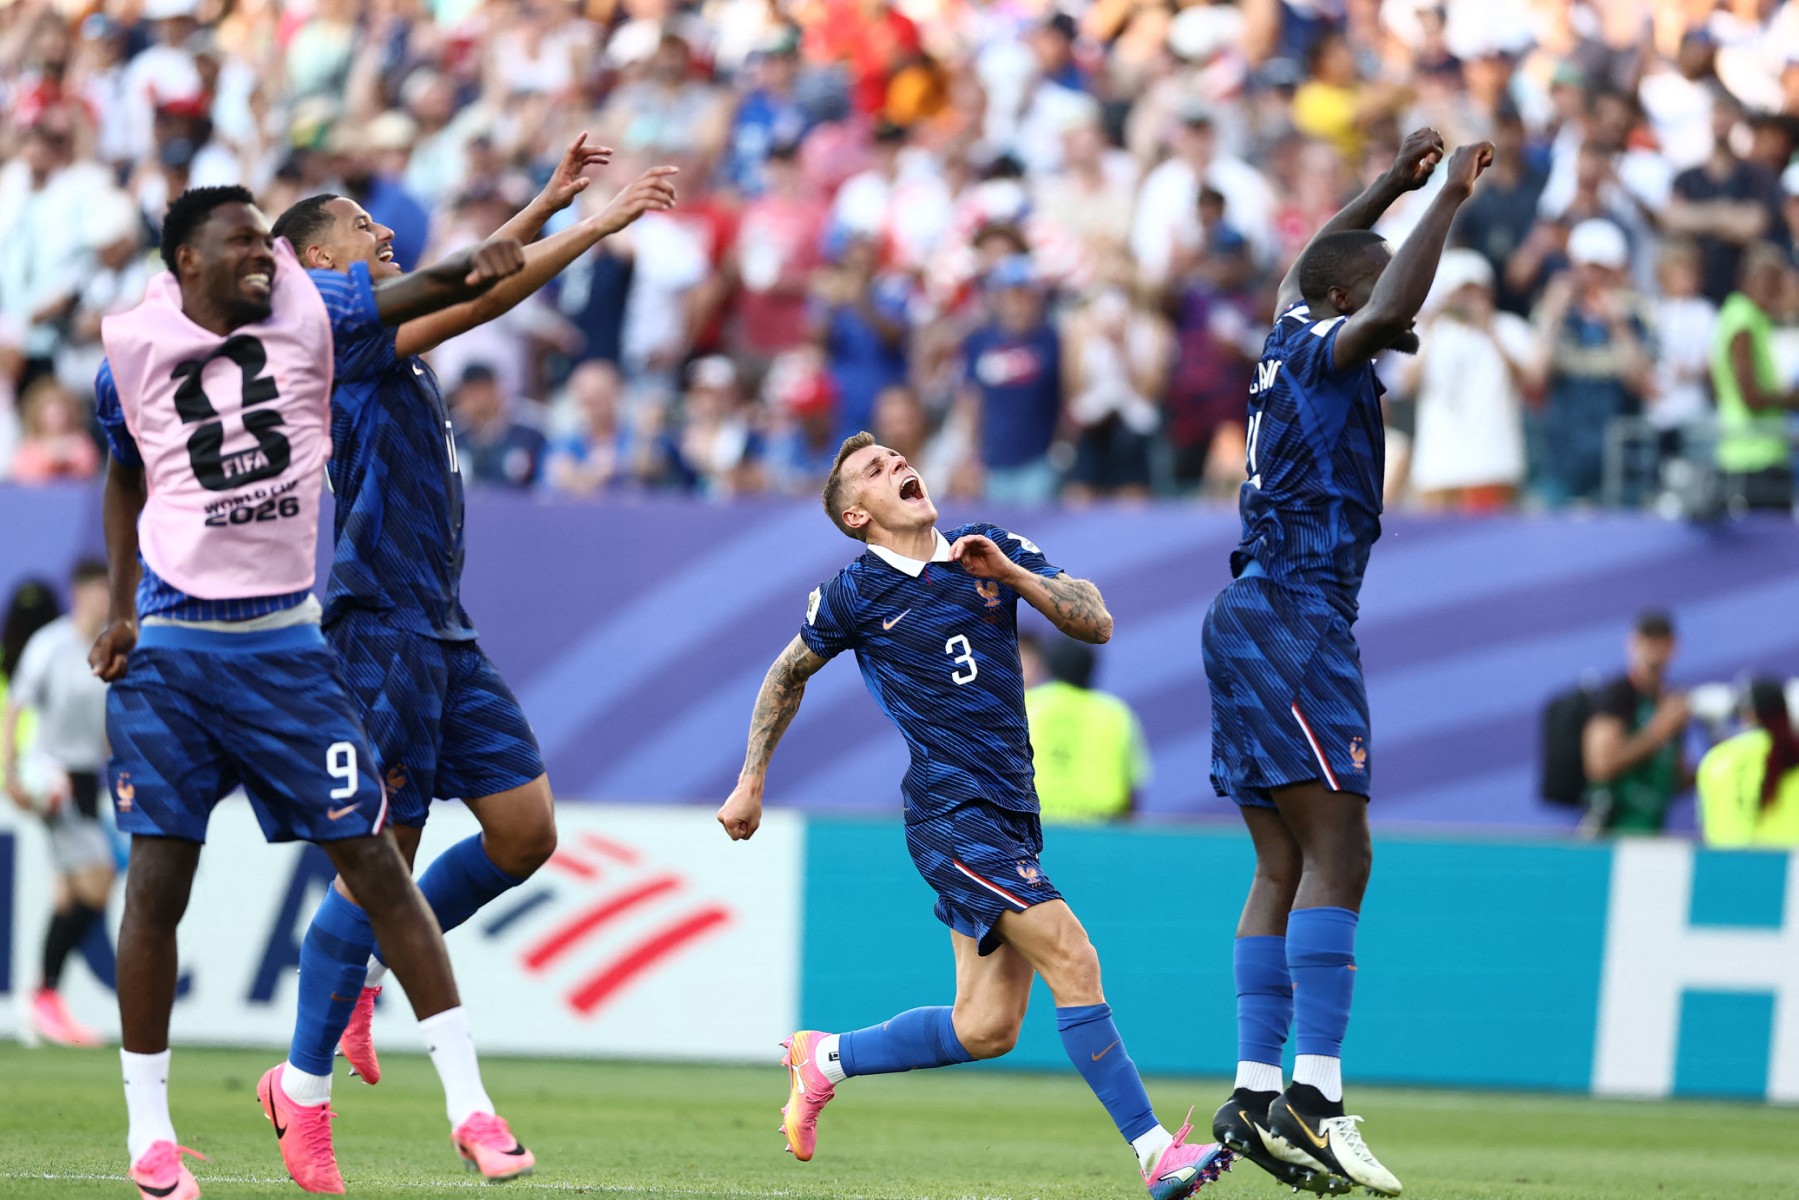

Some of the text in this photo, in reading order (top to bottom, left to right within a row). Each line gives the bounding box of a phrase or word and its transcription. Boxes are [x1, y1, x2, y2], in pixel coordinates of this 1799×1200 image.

[221, 450, 270, 478] FIFA
[204, 489, 267, 513] WORLD
[205, 497, 299, 527] 2026
[945, 634, 978, 685] 3
[326, 741, 358, 799] 9
